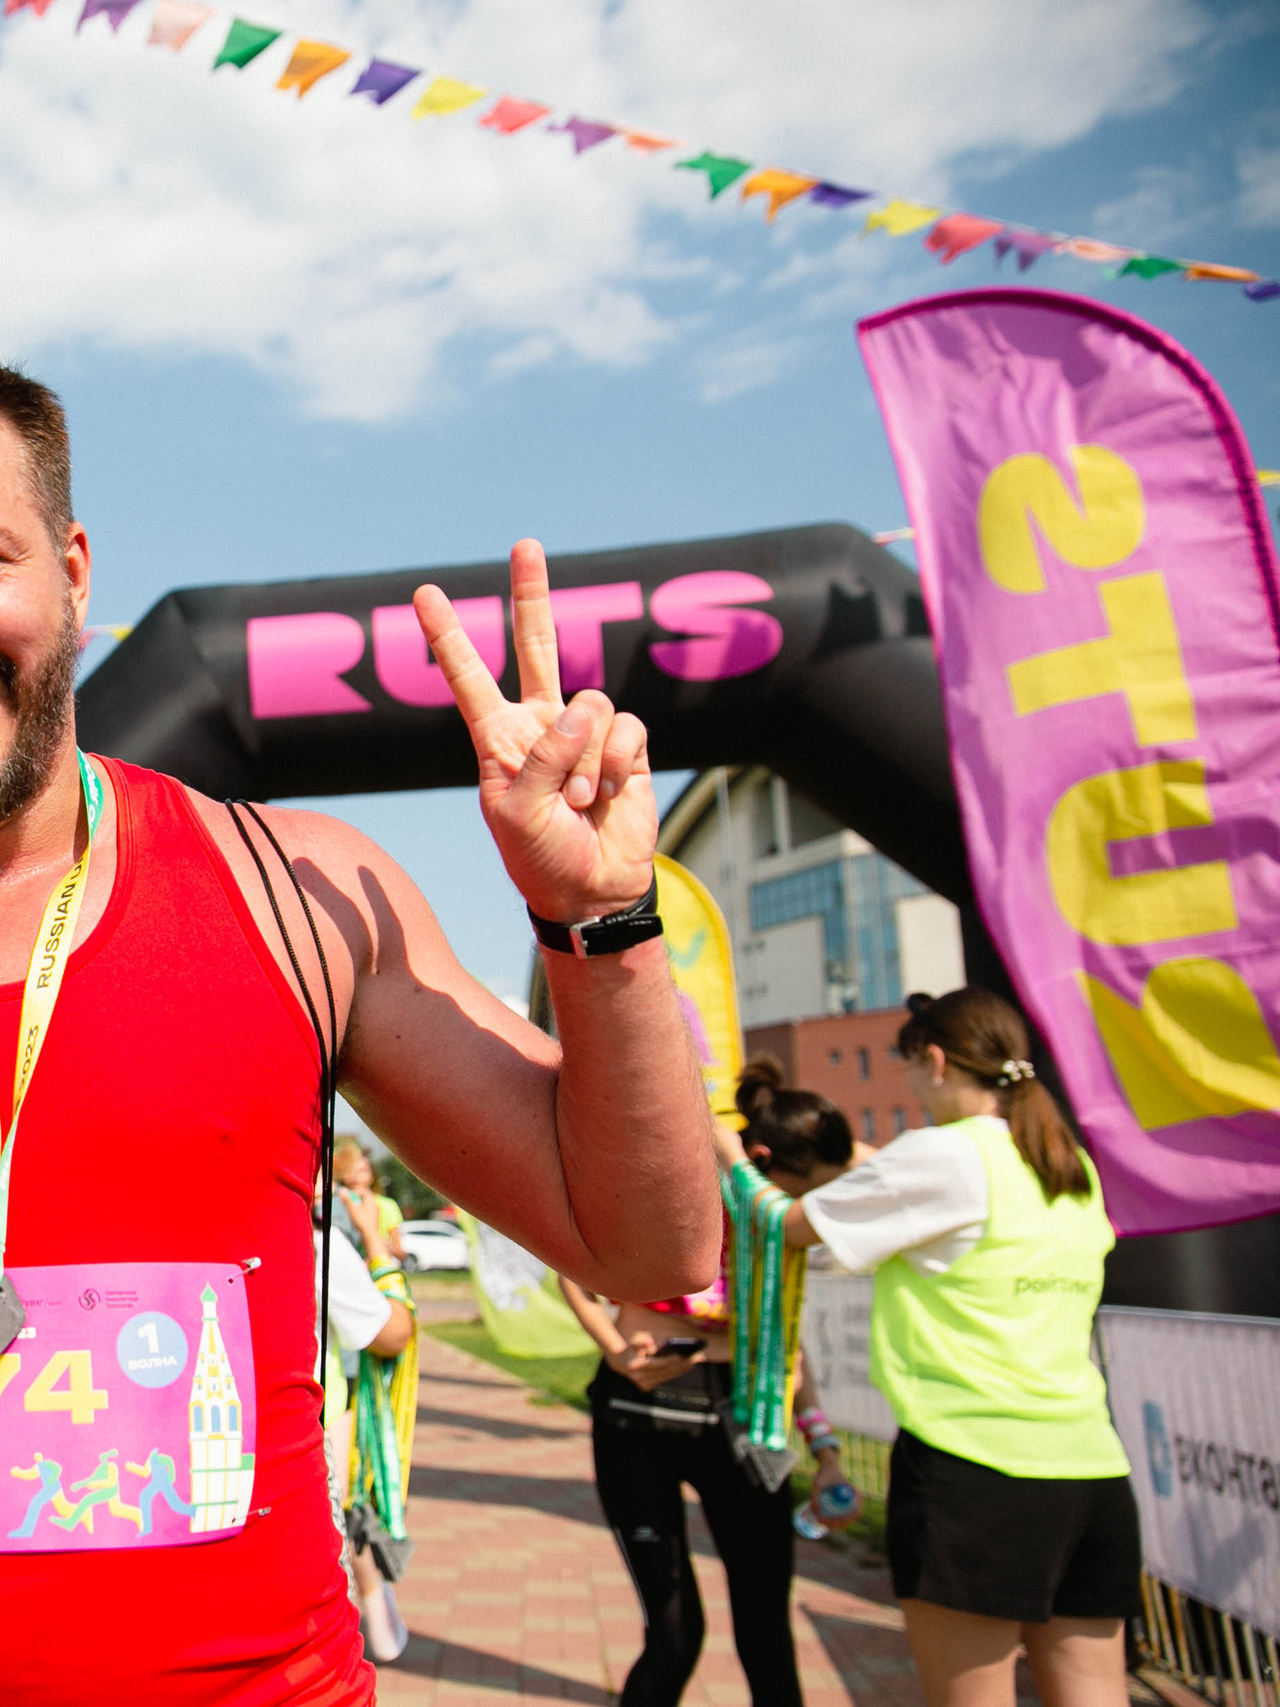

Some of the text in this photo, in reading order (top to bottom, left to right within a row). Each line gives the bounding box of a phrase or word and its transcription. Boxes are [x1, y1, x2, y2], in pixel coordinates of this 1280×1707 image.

[247, 570, 783, 720] RUTS
[36, 883, 76, 990] RUSSIAN
[127, 1355, 178, 1371] ВОЛНА
[138, 1322, 160, 1354] 1
